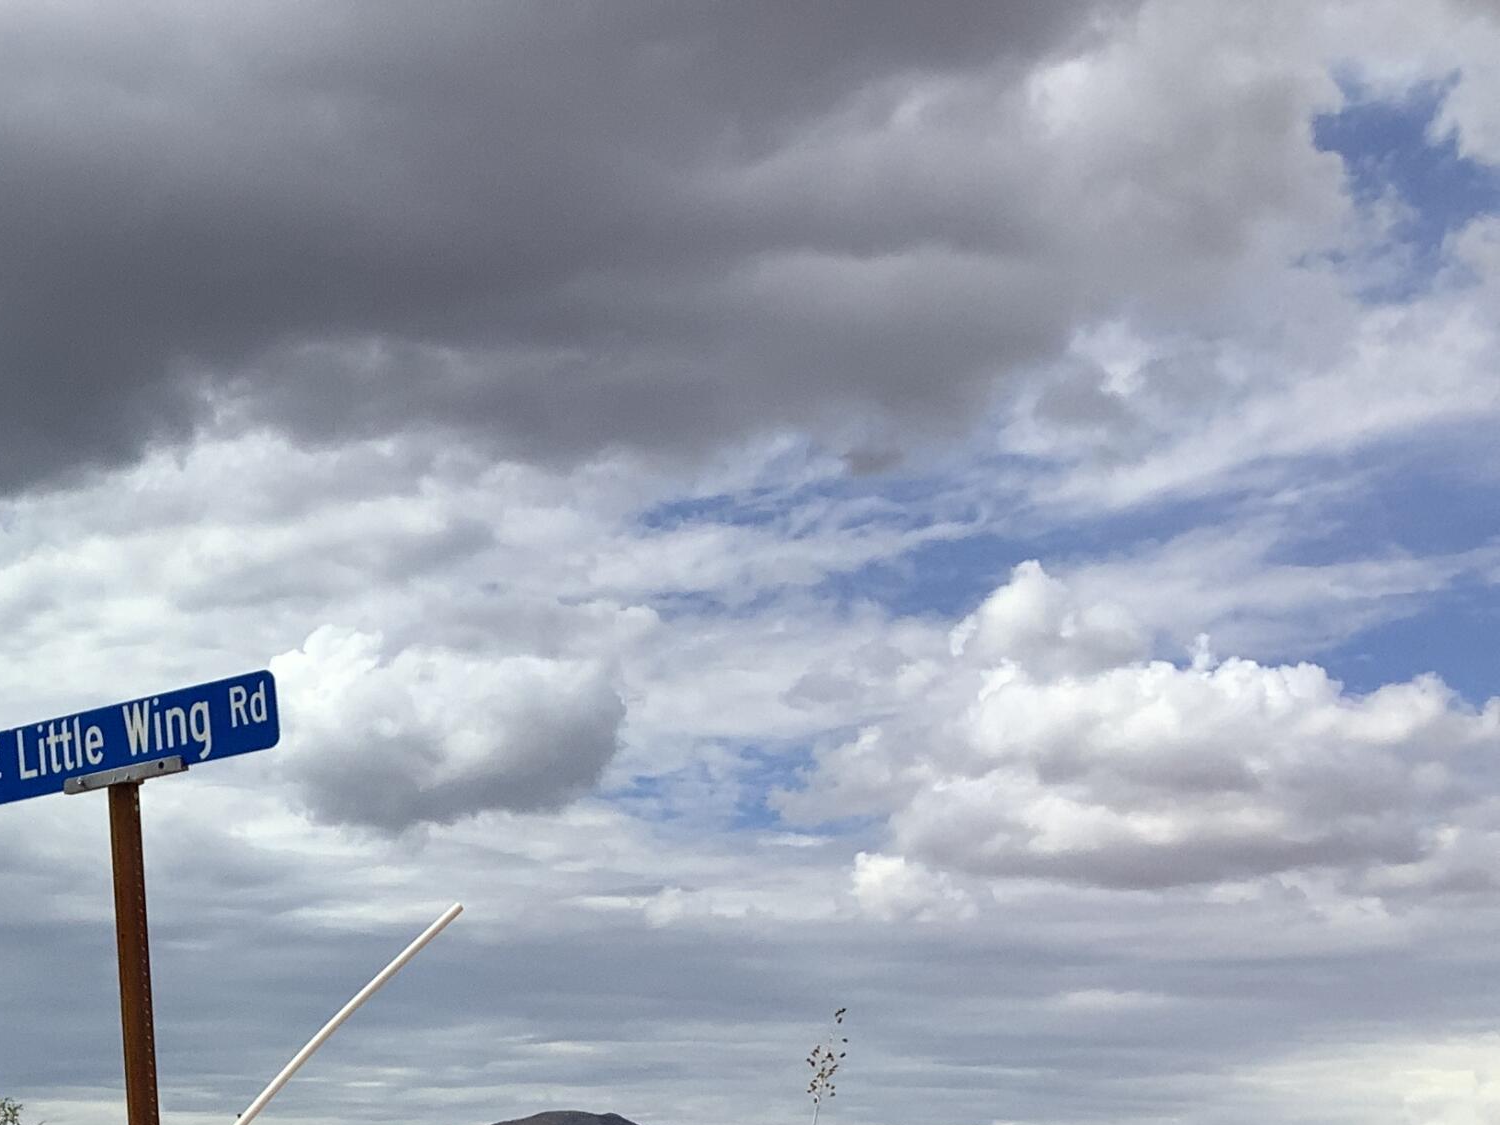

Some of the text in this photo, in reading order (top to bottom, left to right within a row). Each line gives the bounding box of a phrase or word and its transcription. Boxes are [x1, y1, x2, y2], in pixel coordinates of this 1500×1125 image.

[16, 716, 104, 780] Little
[122, 697, 212, 759] Wing
[228, 680, 268, 728] Rd
